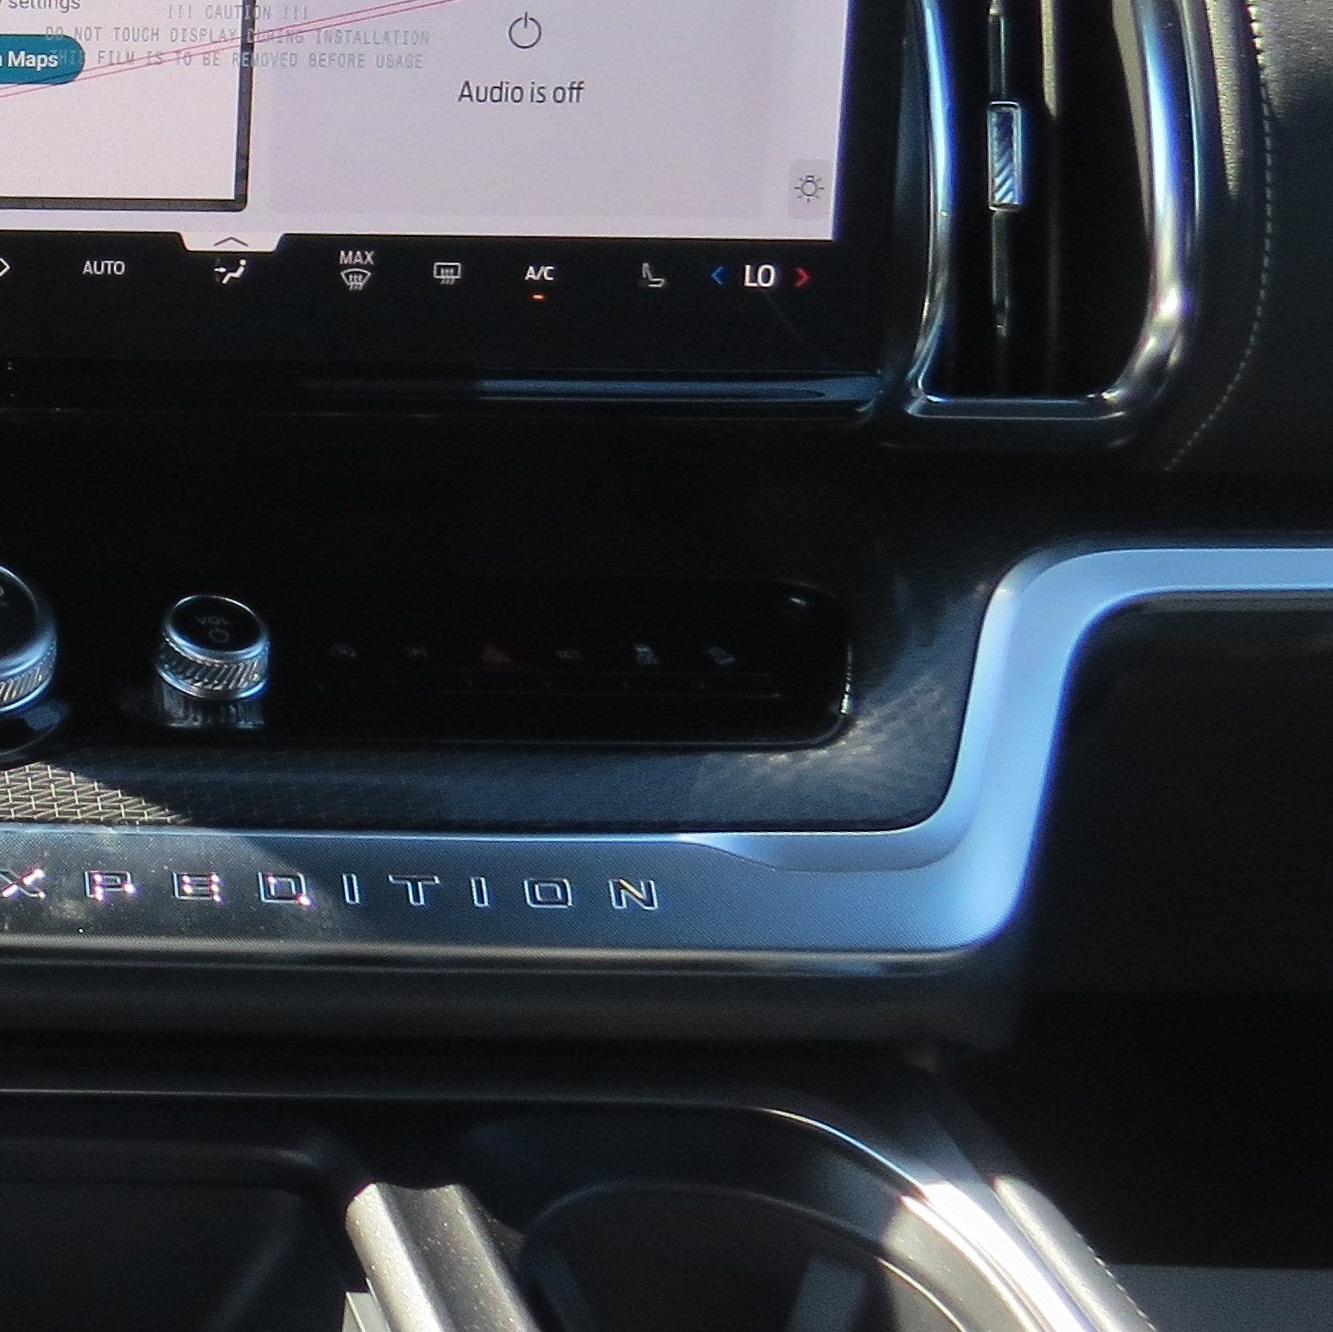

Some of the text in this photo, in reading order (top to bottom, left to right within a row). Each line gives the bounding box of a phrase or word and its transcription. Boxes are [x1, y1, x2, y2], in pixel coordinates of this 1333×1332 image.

[205, 4, 271, 20] CAUTION
[74, 26, 103, 42] NOT
[113, 26, 160, 42] TOUCH
[170, 27, 238, 43] DISPLAY
[315, 29, 430, 45] INSTALLATION
[7, 49, 59, 72] Maps
[147, 50, 163, 66] IS
[176, 51, 192, 66] TO
[202, 51, 221, 66] BE
[232, 52, 298, 68] REMOVED
[309, 53, 365, 68] BEFORE
[375, 54, 423, 69] USAGE
[457, 79, 585, 104] Audio is off
[338, 249, 376, 266] MAX
[82, 259, 126, 276] AUTO
[523, 264, 556, 283] A/C
[743, 263, 777, 289] LO
[194, 614, 231, 626] VOL
